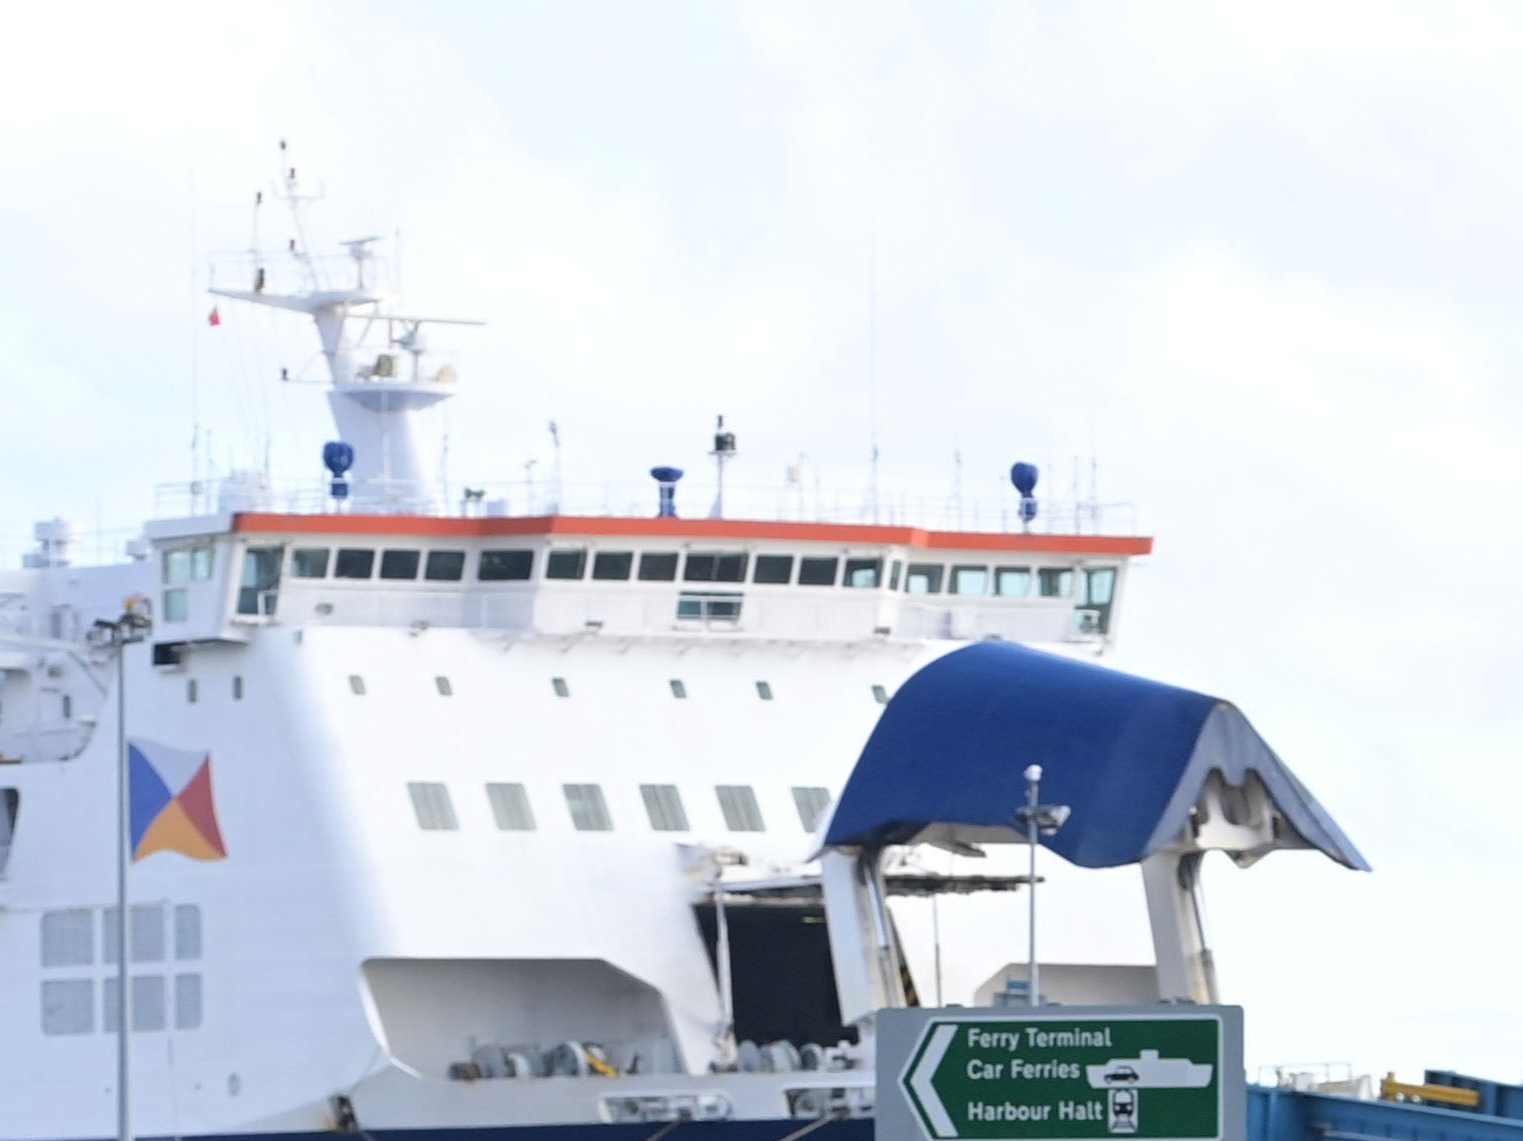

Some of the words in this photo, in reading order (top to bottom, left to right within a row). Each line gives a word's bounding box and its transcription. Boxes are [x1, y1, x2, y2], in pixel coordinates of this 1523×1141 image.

[967, 1028, 1020, 1050] Ferry
[1025, 1027, 1112, 1047] Terminal
[967, 1060, 1003, 1079] Car
[1010, 1060, 1081, 1079] Ferries
[967, 1102, 1051, 1121] Harbour
[1059, 1101, 1103, 1121] Halt
